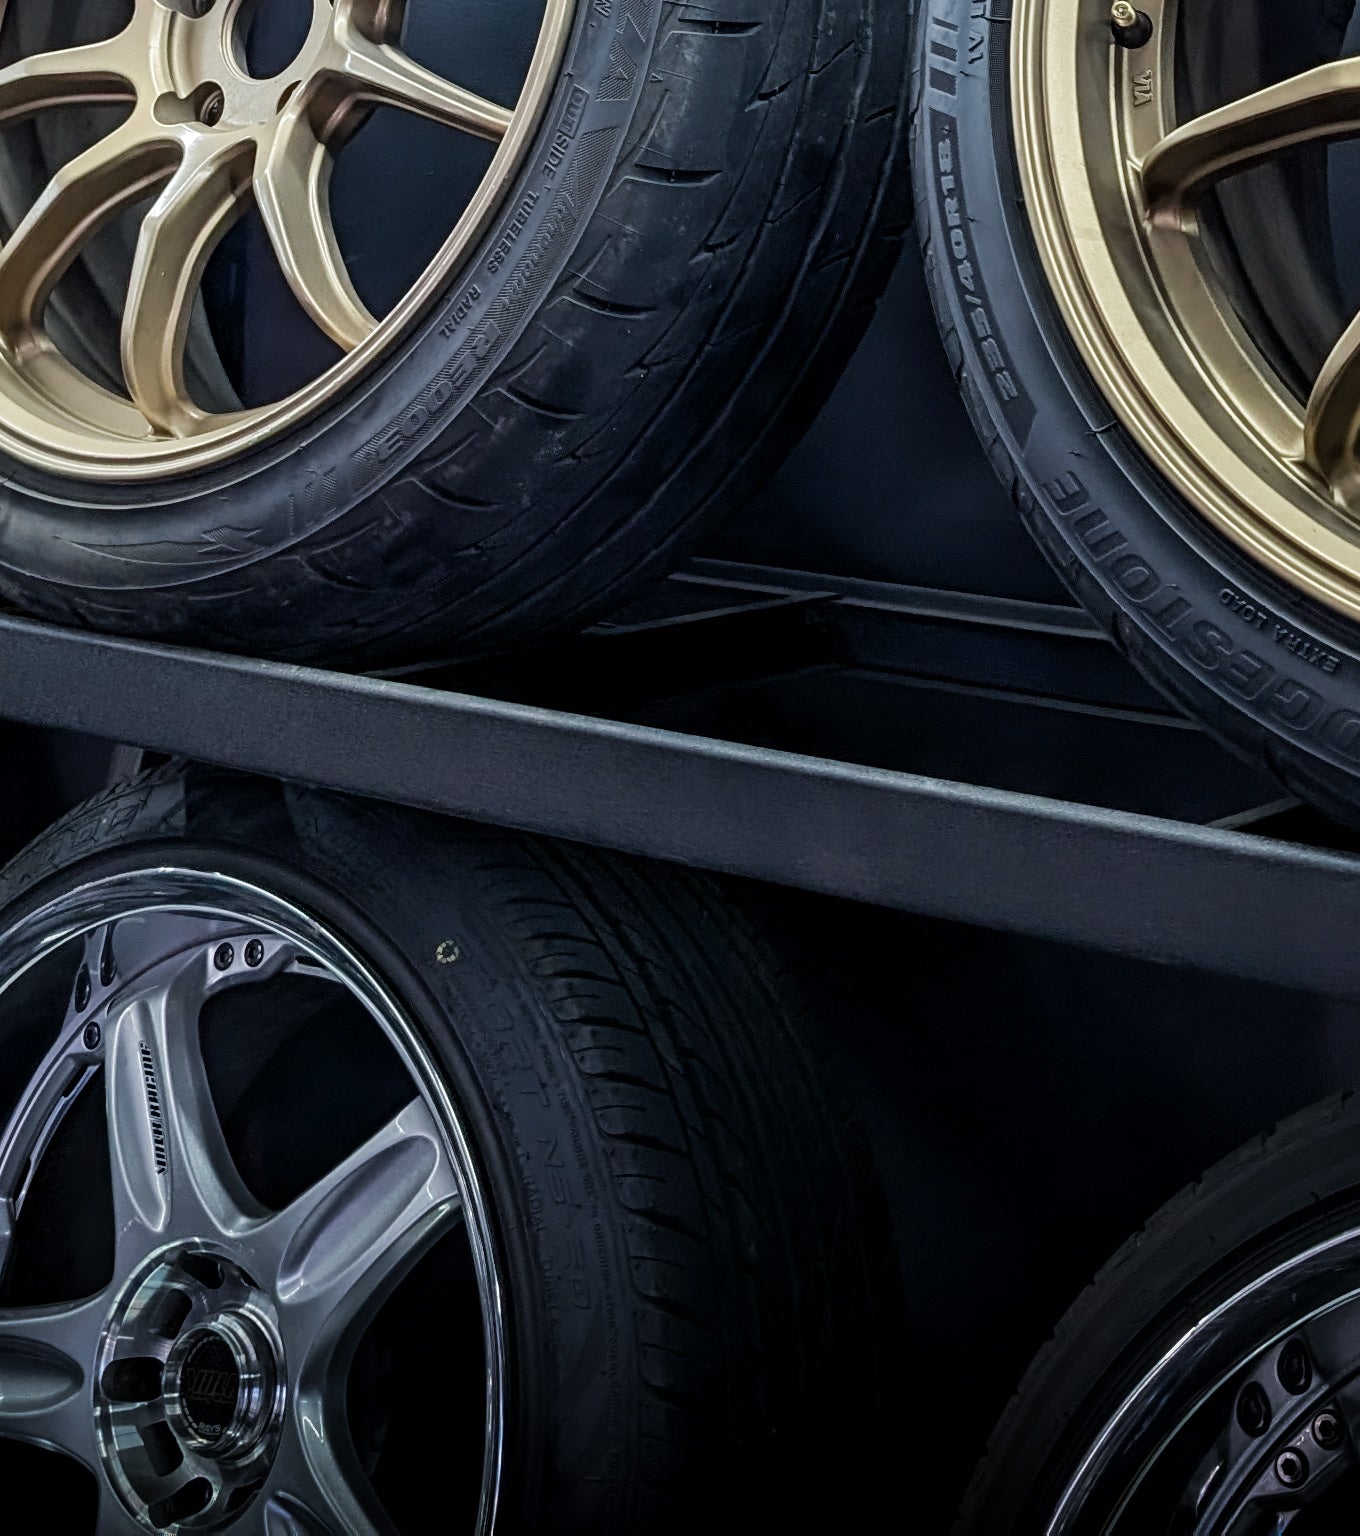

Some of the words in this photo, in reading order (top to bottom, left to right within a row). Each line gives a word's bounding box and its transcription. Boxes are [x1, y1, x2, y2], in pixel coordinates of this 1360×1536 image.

[936, 136, 1019, 401] 235/40R18
[1218, 588, 1270, 626] LOAD
[1271, 628, 1340, 673] EXTRA
